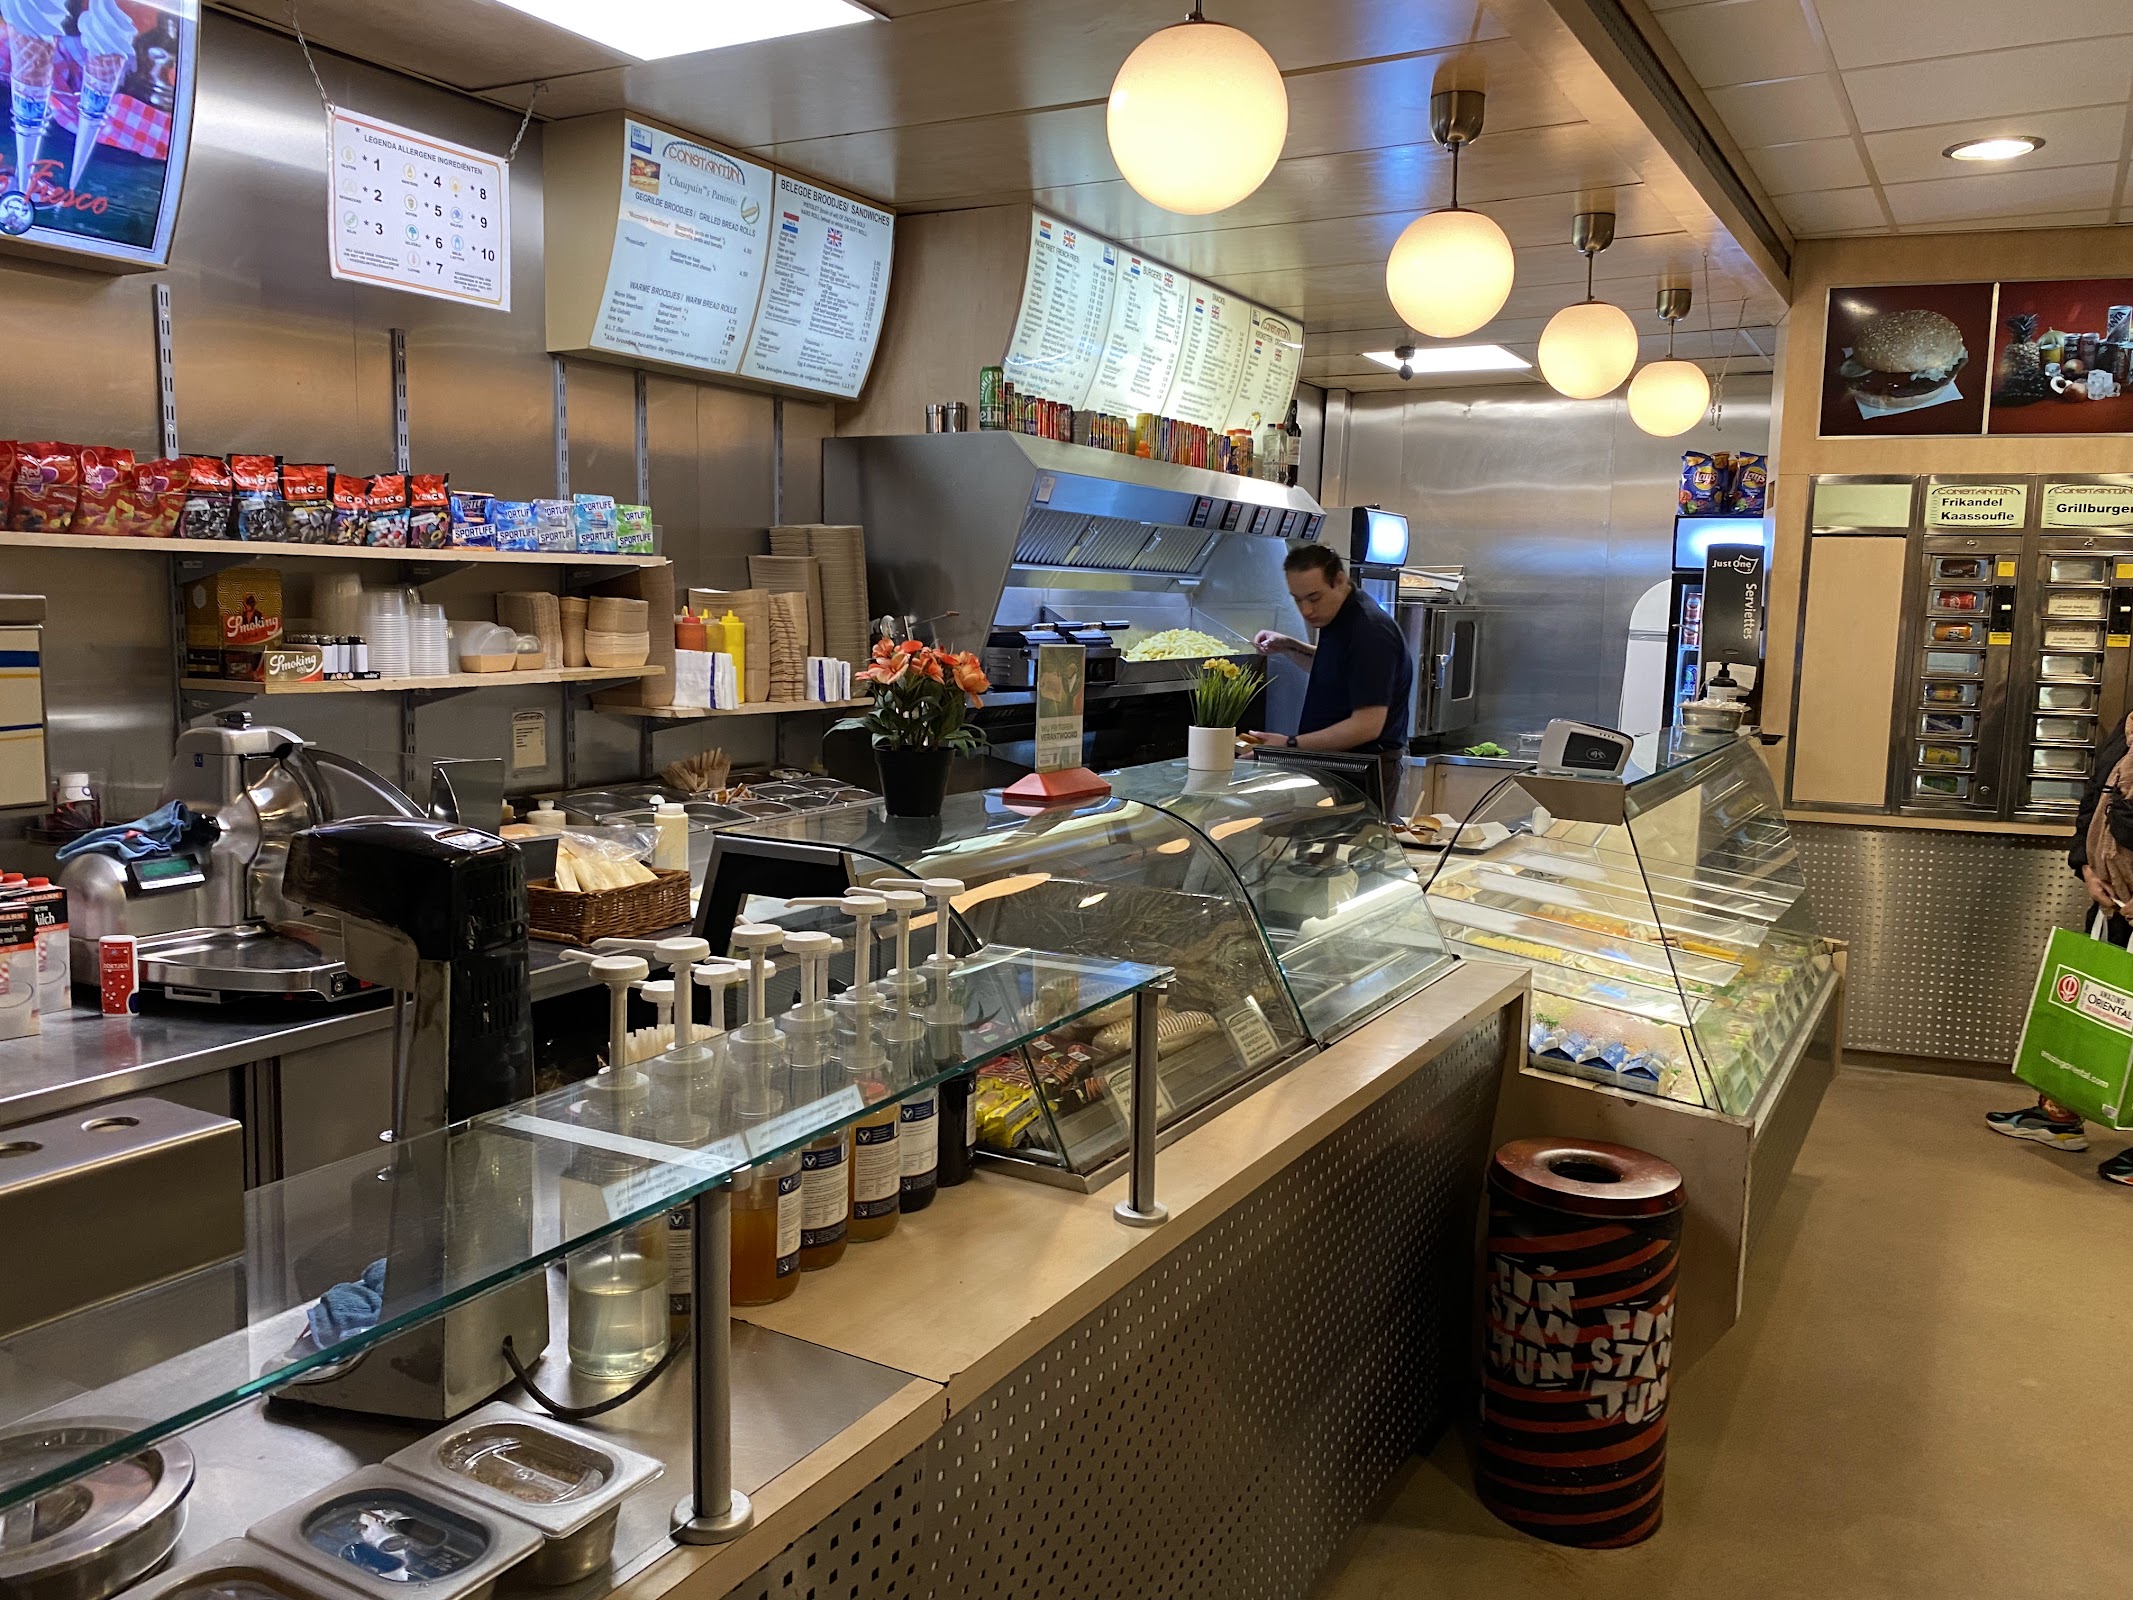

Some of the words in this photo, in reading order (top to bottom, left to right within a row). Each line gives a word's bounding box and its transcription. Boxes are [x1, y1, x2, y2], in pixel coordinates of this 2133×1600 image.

[364, 134, 396, 150] LEGENDA
[397, 143, 436, 162] ALLERGENE
[437, 154, 482, 175] INGREDIËNTEN
[374, 157, 379, 171] 1
[434, 174, 441, 187] 4
[374, 188, 382, 202] 2
[479, 187, 486, 200] 8
[780, 179, 812, 199] BELEGDE
[850, 204, 890, 226] SANDWICHES
[434, 205, 441, 217] 5
[635, 191, 663, 207] GEGRILDE
[663, 200, 693, 217] BROODJES
[698, 212, 721, 226] GRILLED
[721, 219, 739, 232] BREAD
[739, 225, 756, 237] ROLLS
[375, 222, 382, 235] 3
[480, 217, 486, 228] 9
[435, 237, 442, 249] 6
[481, 248, 494, 262] 10
[436, 263, 442, 275] 7
[629, 280, 651, 293] WARME
[650, 286, 680, 301] BROODJES
[685, 295, 702, 306] WARM
[702, 299, 720, 310] BREAD
[720, 303, 737, 314] ROLLS
[1694, 471, 1717, 486] Lay's
[1743, 470, 1766, 483] Lay's
[287, 485, 325, 494] VENCO
[367, 495, 404, 505] VENCO
[415, 493, 444, 501] VENCO
[1942, 497, 2003, 507] Frikandel
[583, 500, 612, 512] PORTLIFE
[1941, 511, 2015, 521] Kaassoufle
[455, 525, 493, 539] SPORTLIFE
[500, 527, 536, 541] SPORTLIFE
[541, 530, 574, 543] SPORTLIFE
[582, 530, 615, 543] SPORTLIFE
[620, 533, 651, 545] SPORTLIFE
[1743, 583, 1757, 640] Serviettes
[226, 615, 278, 637] Smoking
[269, 653, 317, 675] Smoking
[2100, 991, 2126, 1005] AMAZING
[2088, 994, 2132, 1020] ORIENTAL
